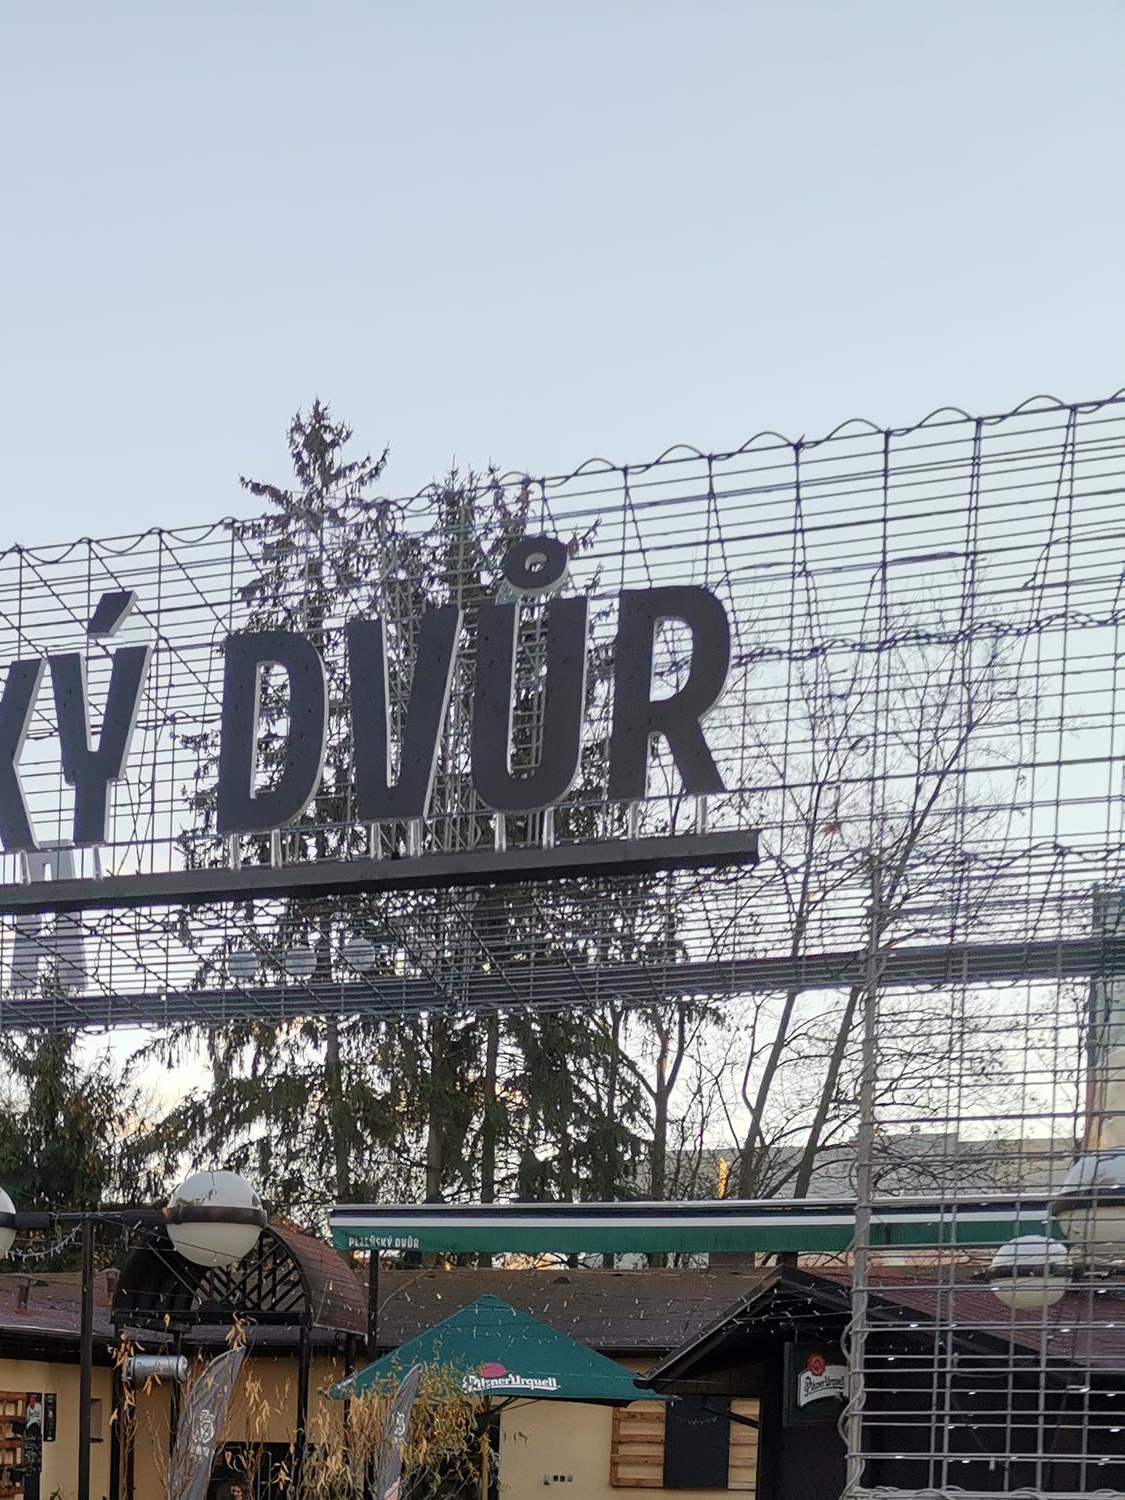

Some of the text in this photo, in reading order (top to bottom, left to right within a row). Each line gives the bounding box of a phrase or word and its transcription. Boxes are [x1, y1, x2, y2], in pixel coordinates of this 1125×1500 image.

[217, 536, 732, 834] DVŮR
[348, 1235, 420, 1249] PLZEŇSKÝ DVŮR
